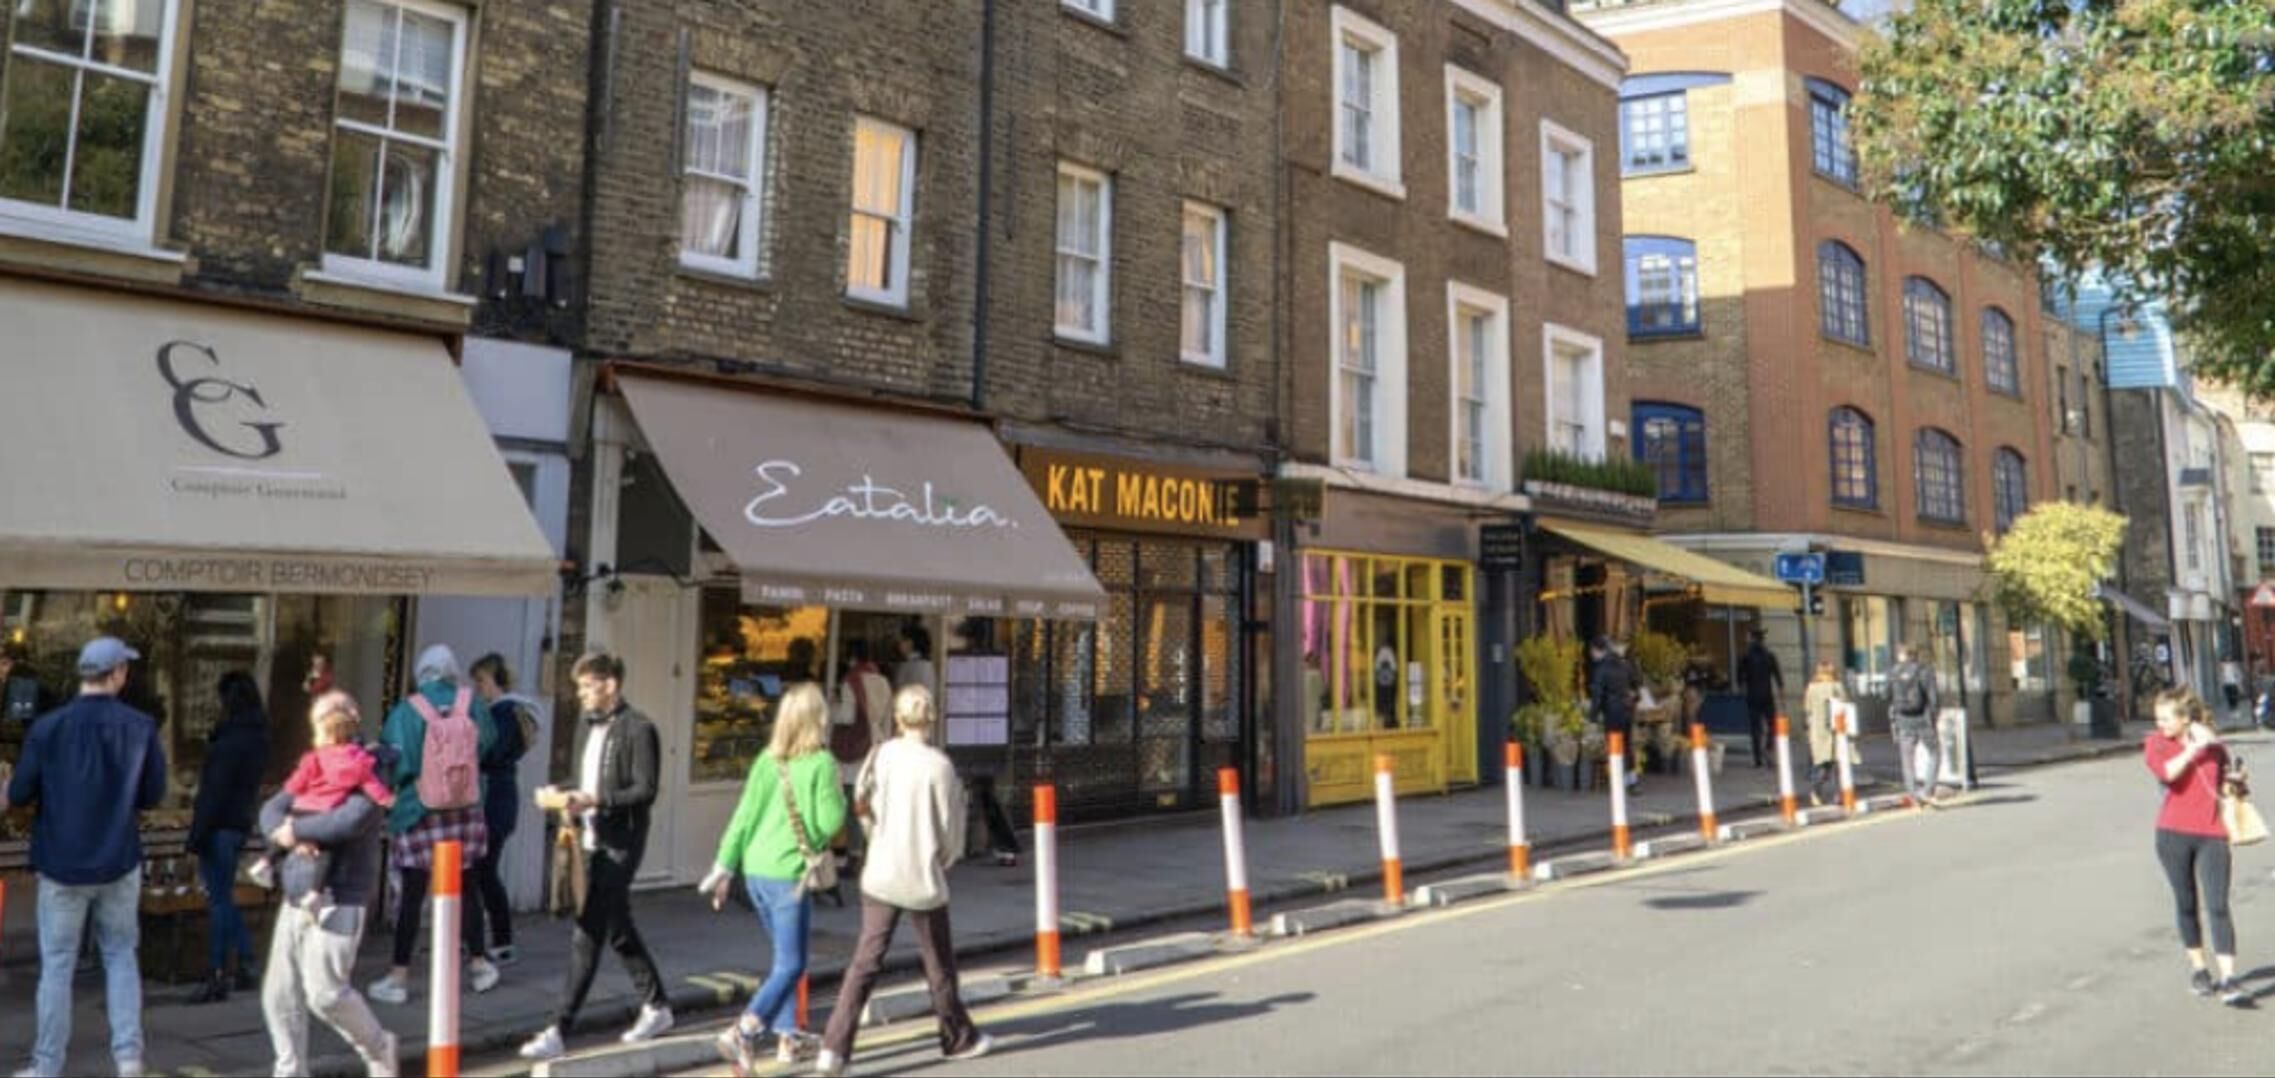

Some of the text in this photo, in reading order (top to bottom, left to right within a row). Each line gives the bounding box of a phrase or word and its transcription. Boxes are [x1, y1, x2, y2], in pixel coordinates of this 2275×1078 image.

[1048, 464, 1104, 513] KAT
[1116, 471, 1239, 526] MACONIE
[124, 557, 437, 589] COMPTOIR BERMONDSEY
